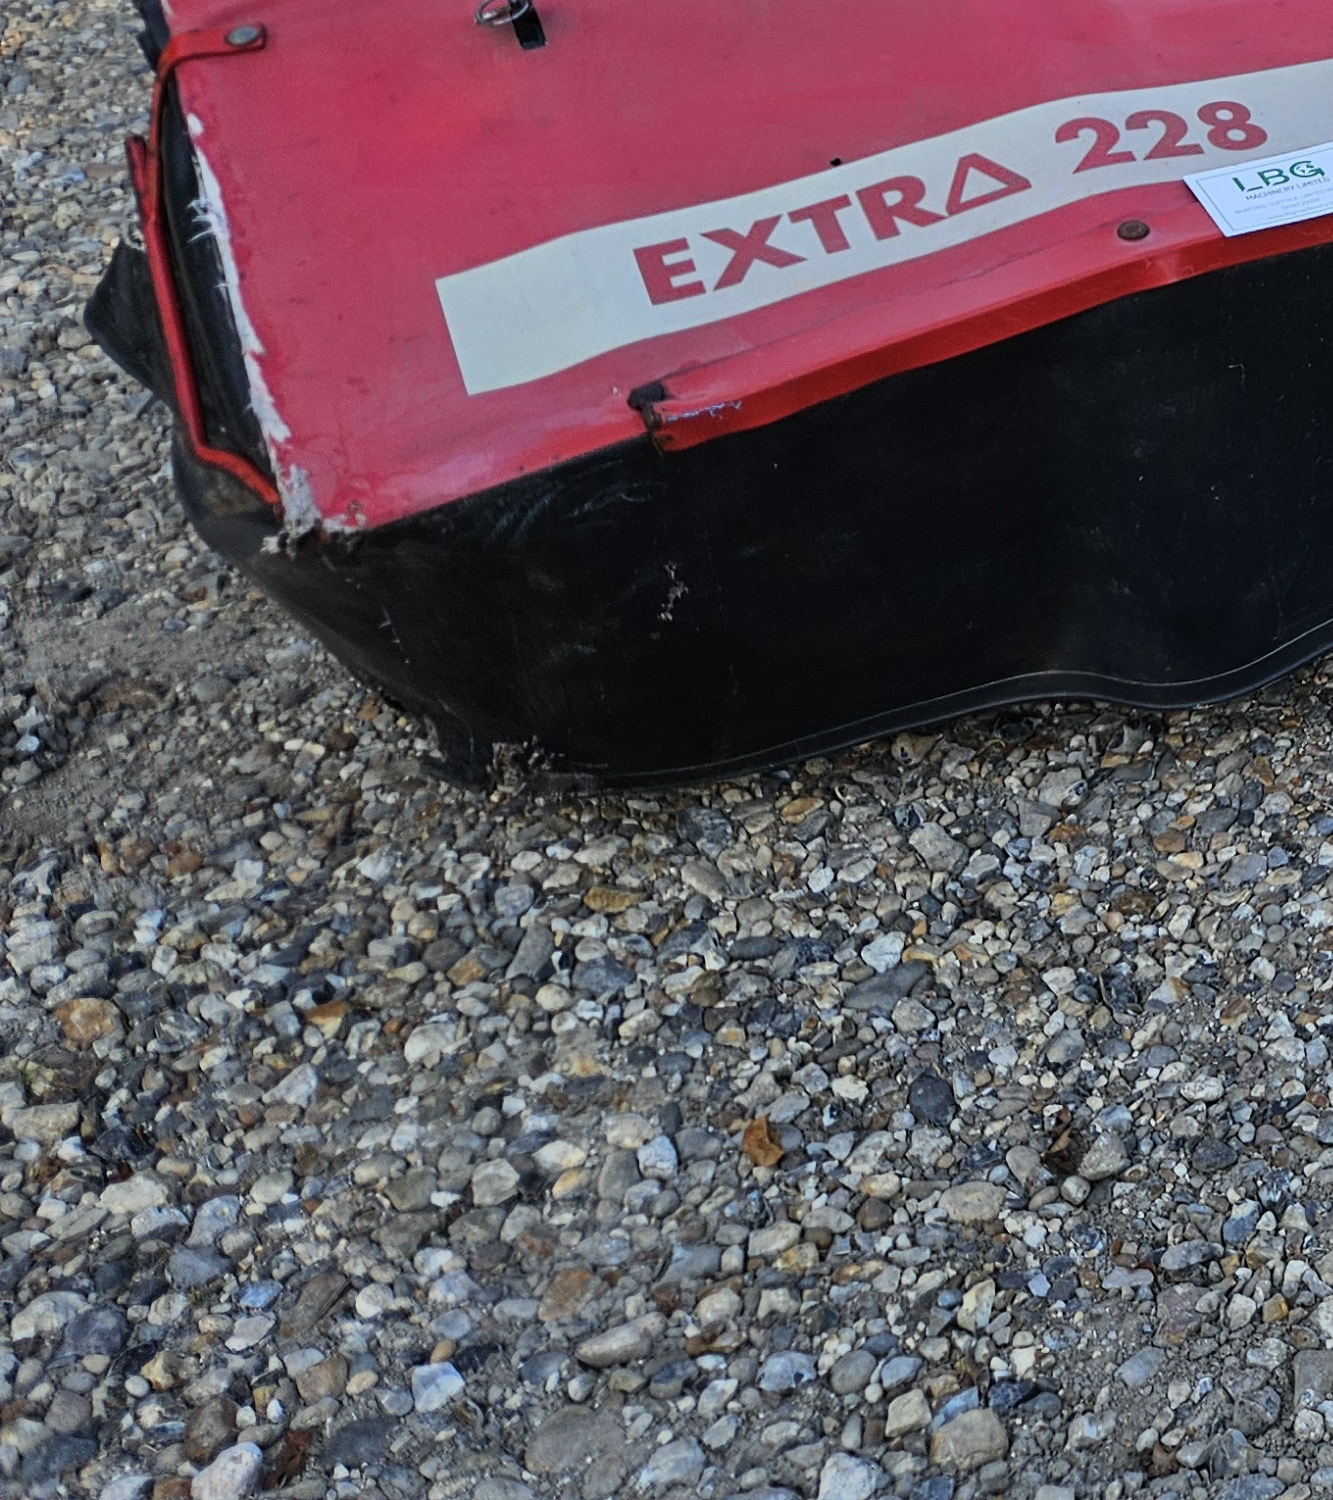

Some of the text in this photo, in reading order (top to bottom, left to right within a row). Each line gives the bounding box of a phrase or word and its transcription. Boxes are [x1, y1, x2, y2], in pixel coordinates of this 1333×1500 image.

[1231, 160, 1326, 192] LBG
[1245, 176, 1331, 201] MACHINERY LIMITED
[633, 101, 1267, 305] EXTRA 228
